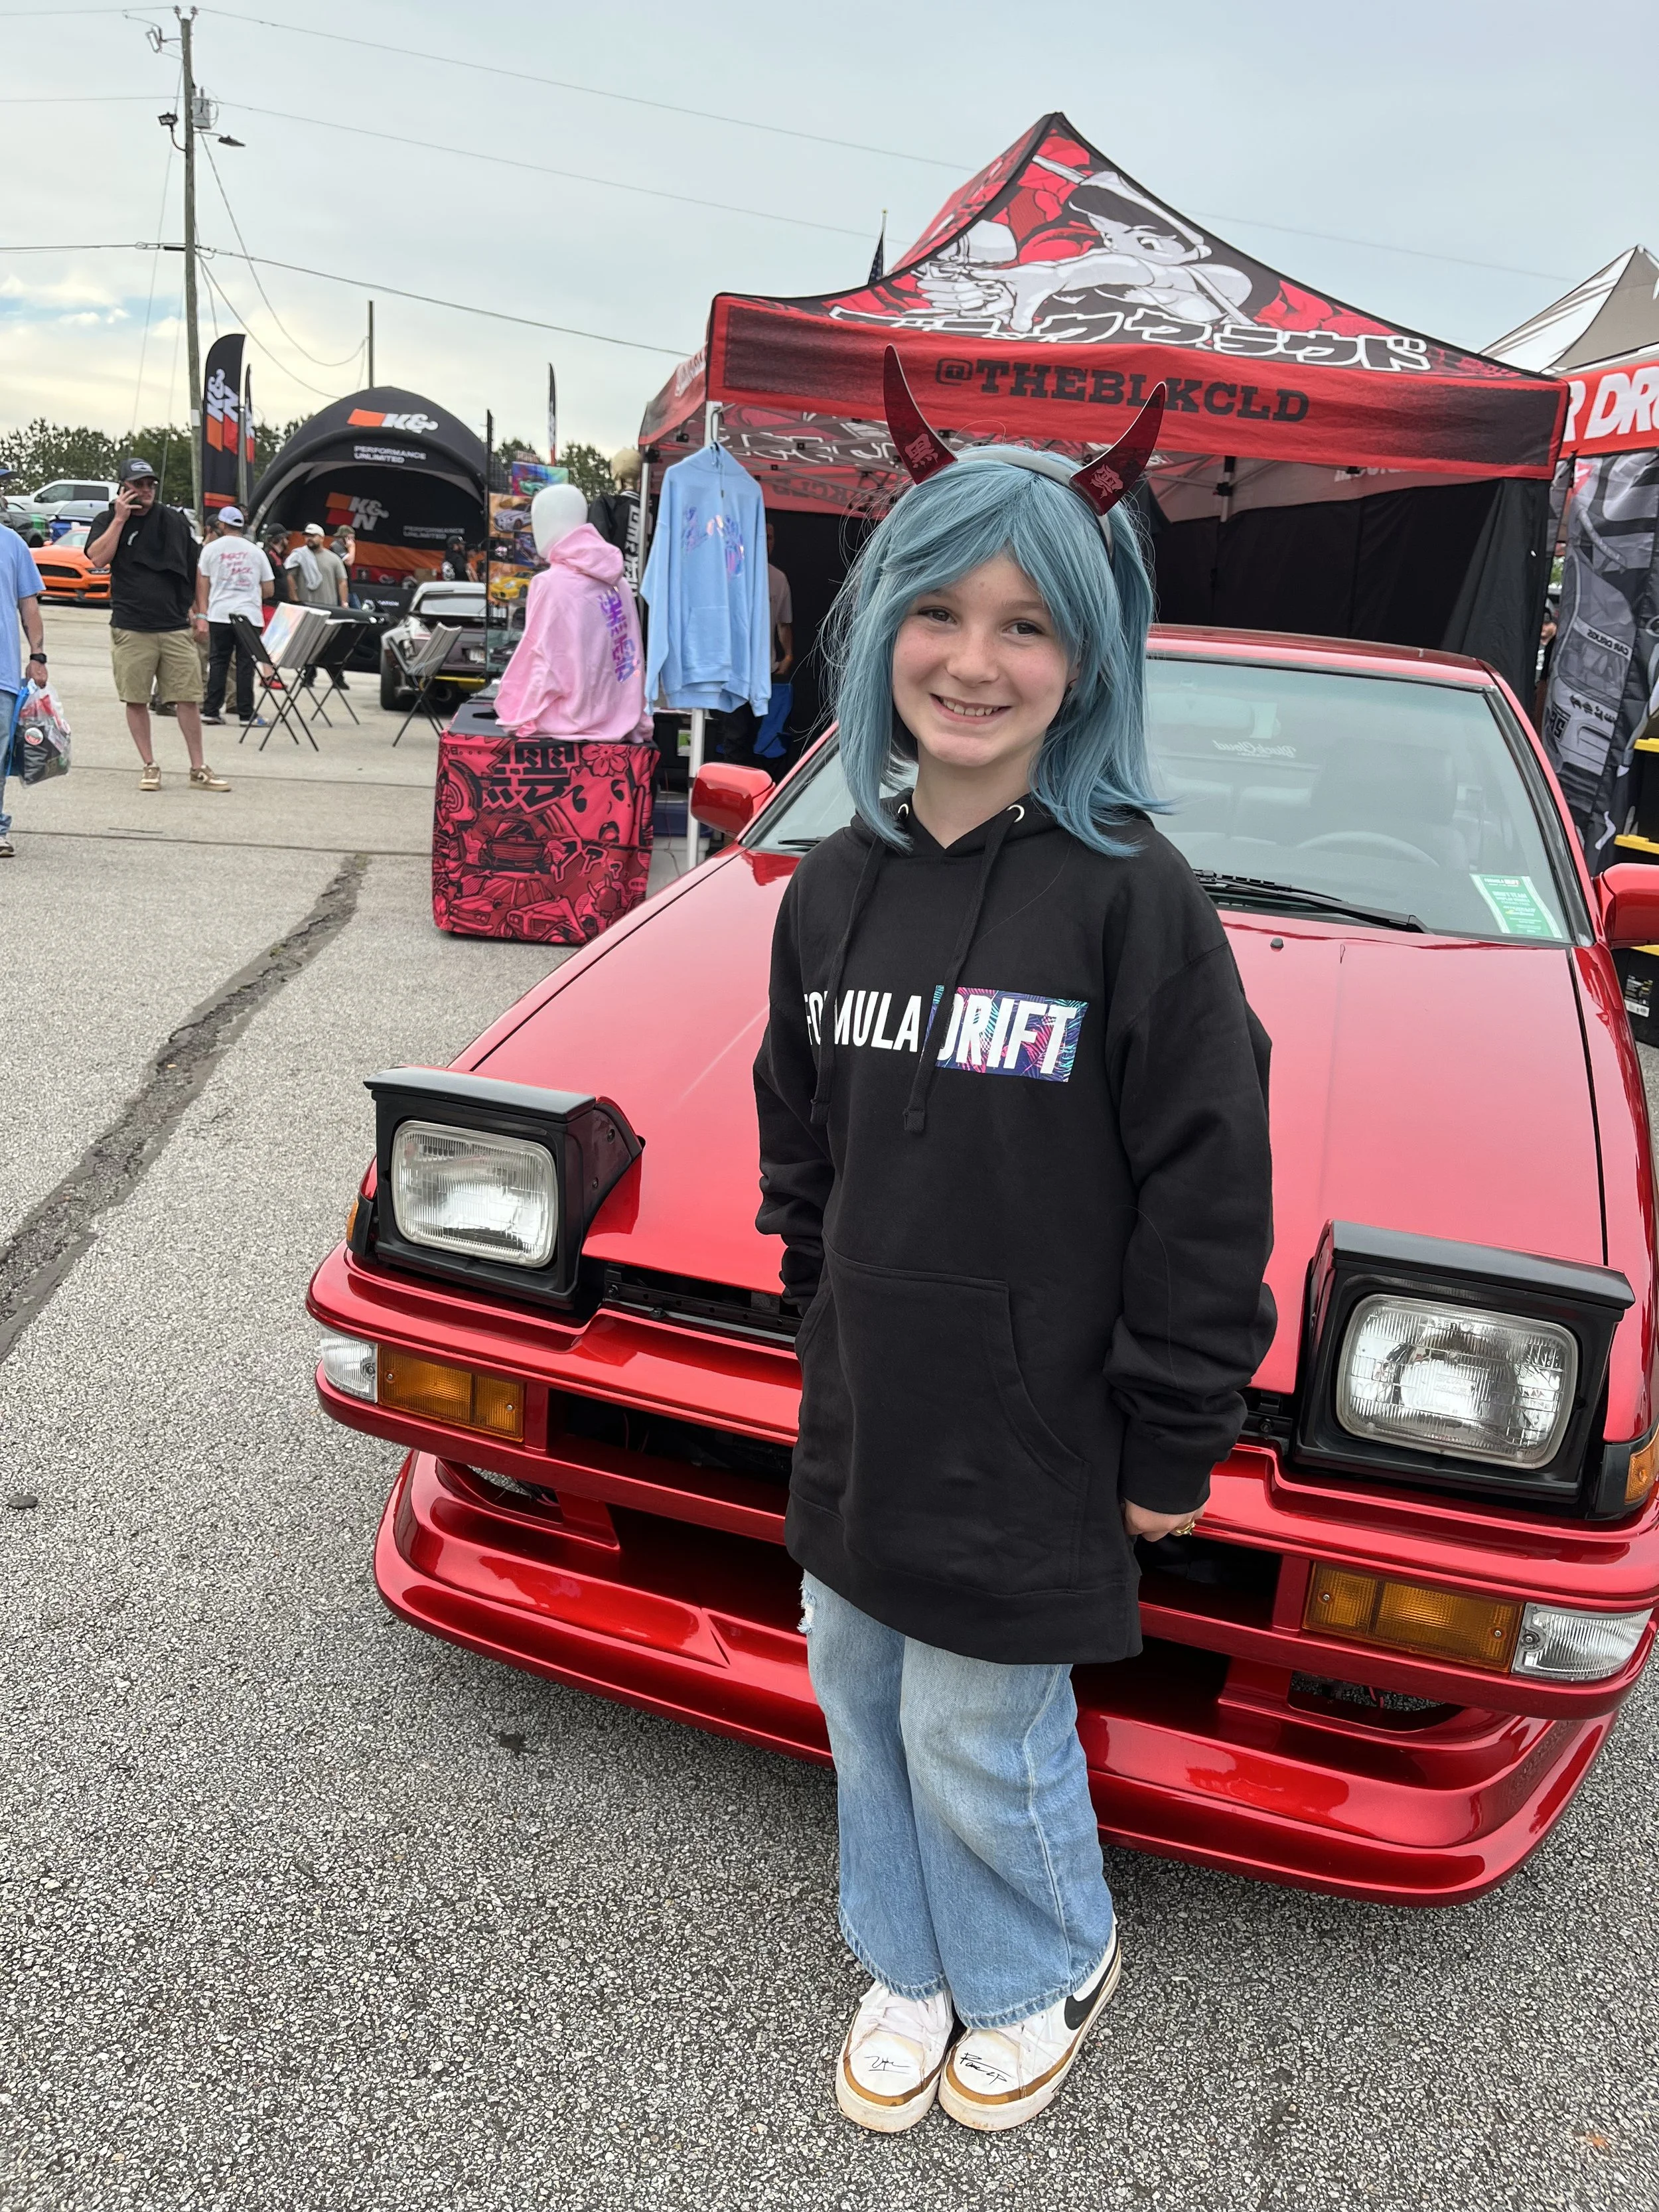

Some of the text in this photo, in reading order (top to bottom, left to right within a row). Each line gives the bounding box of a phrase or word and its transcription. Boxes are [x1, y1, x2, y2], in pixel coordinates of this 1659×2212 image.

[935, 358, 1309, 423] @THEBLKCLD
[354, 445, 427, 461] PERFORMANCE
[354, 453, 405, 464] UNLIMITED
[402, 525, 465, 534] PERFORMANCE
[402, 531, 447, 540] UNLIMITED
[804, 988, 922, 1053] FOMULA
